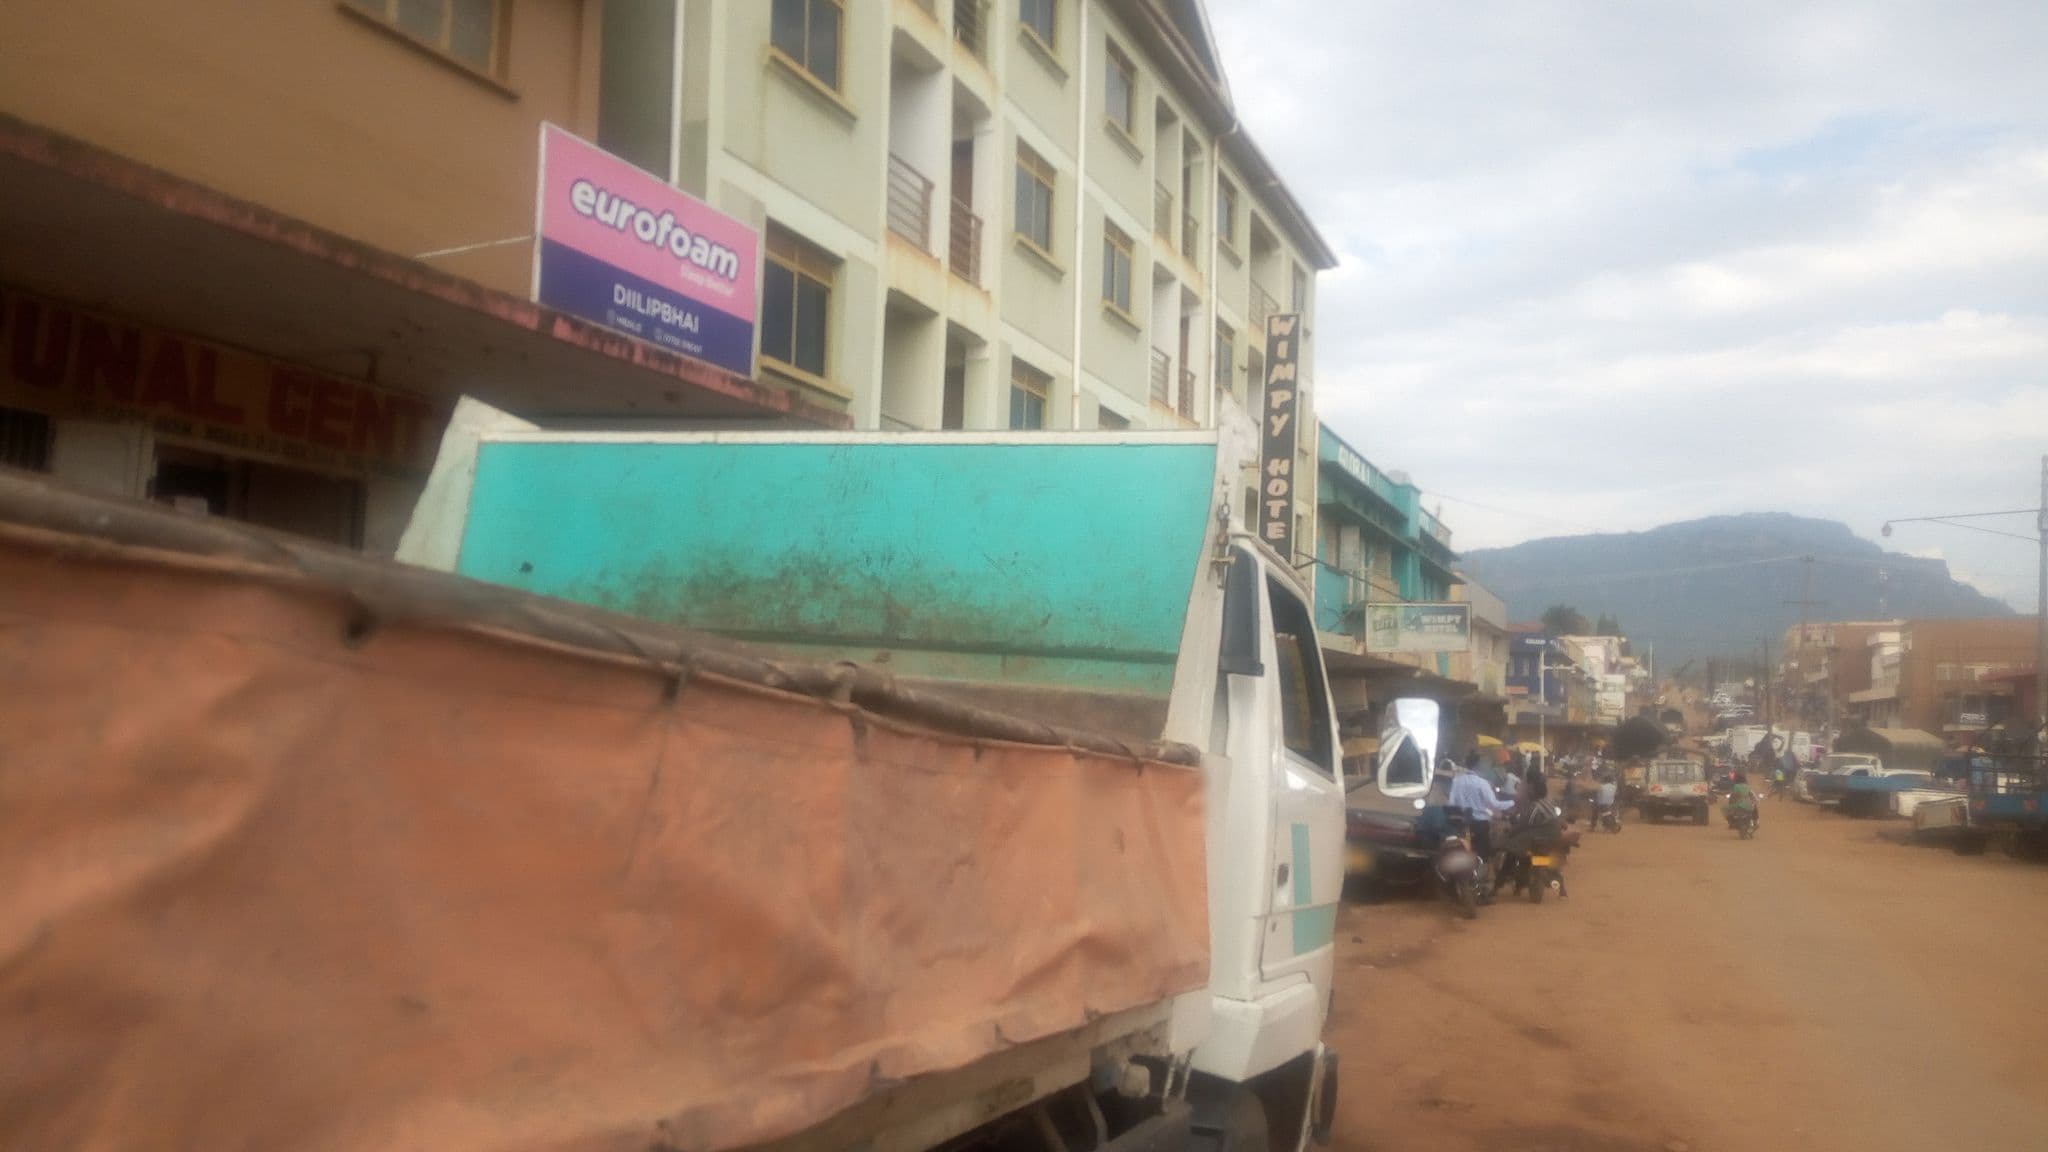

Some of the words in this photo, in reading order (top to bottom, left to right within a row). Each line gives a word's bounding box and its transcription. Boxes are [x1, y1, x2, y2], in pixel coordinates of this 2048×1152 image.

[570, 180, 738, 280] eurofoam
[0, 290, 246, 424] UNAL
[1268, 316, 1296, 437] WIMPY
[1266, 458, 1290, 547] HOTE
